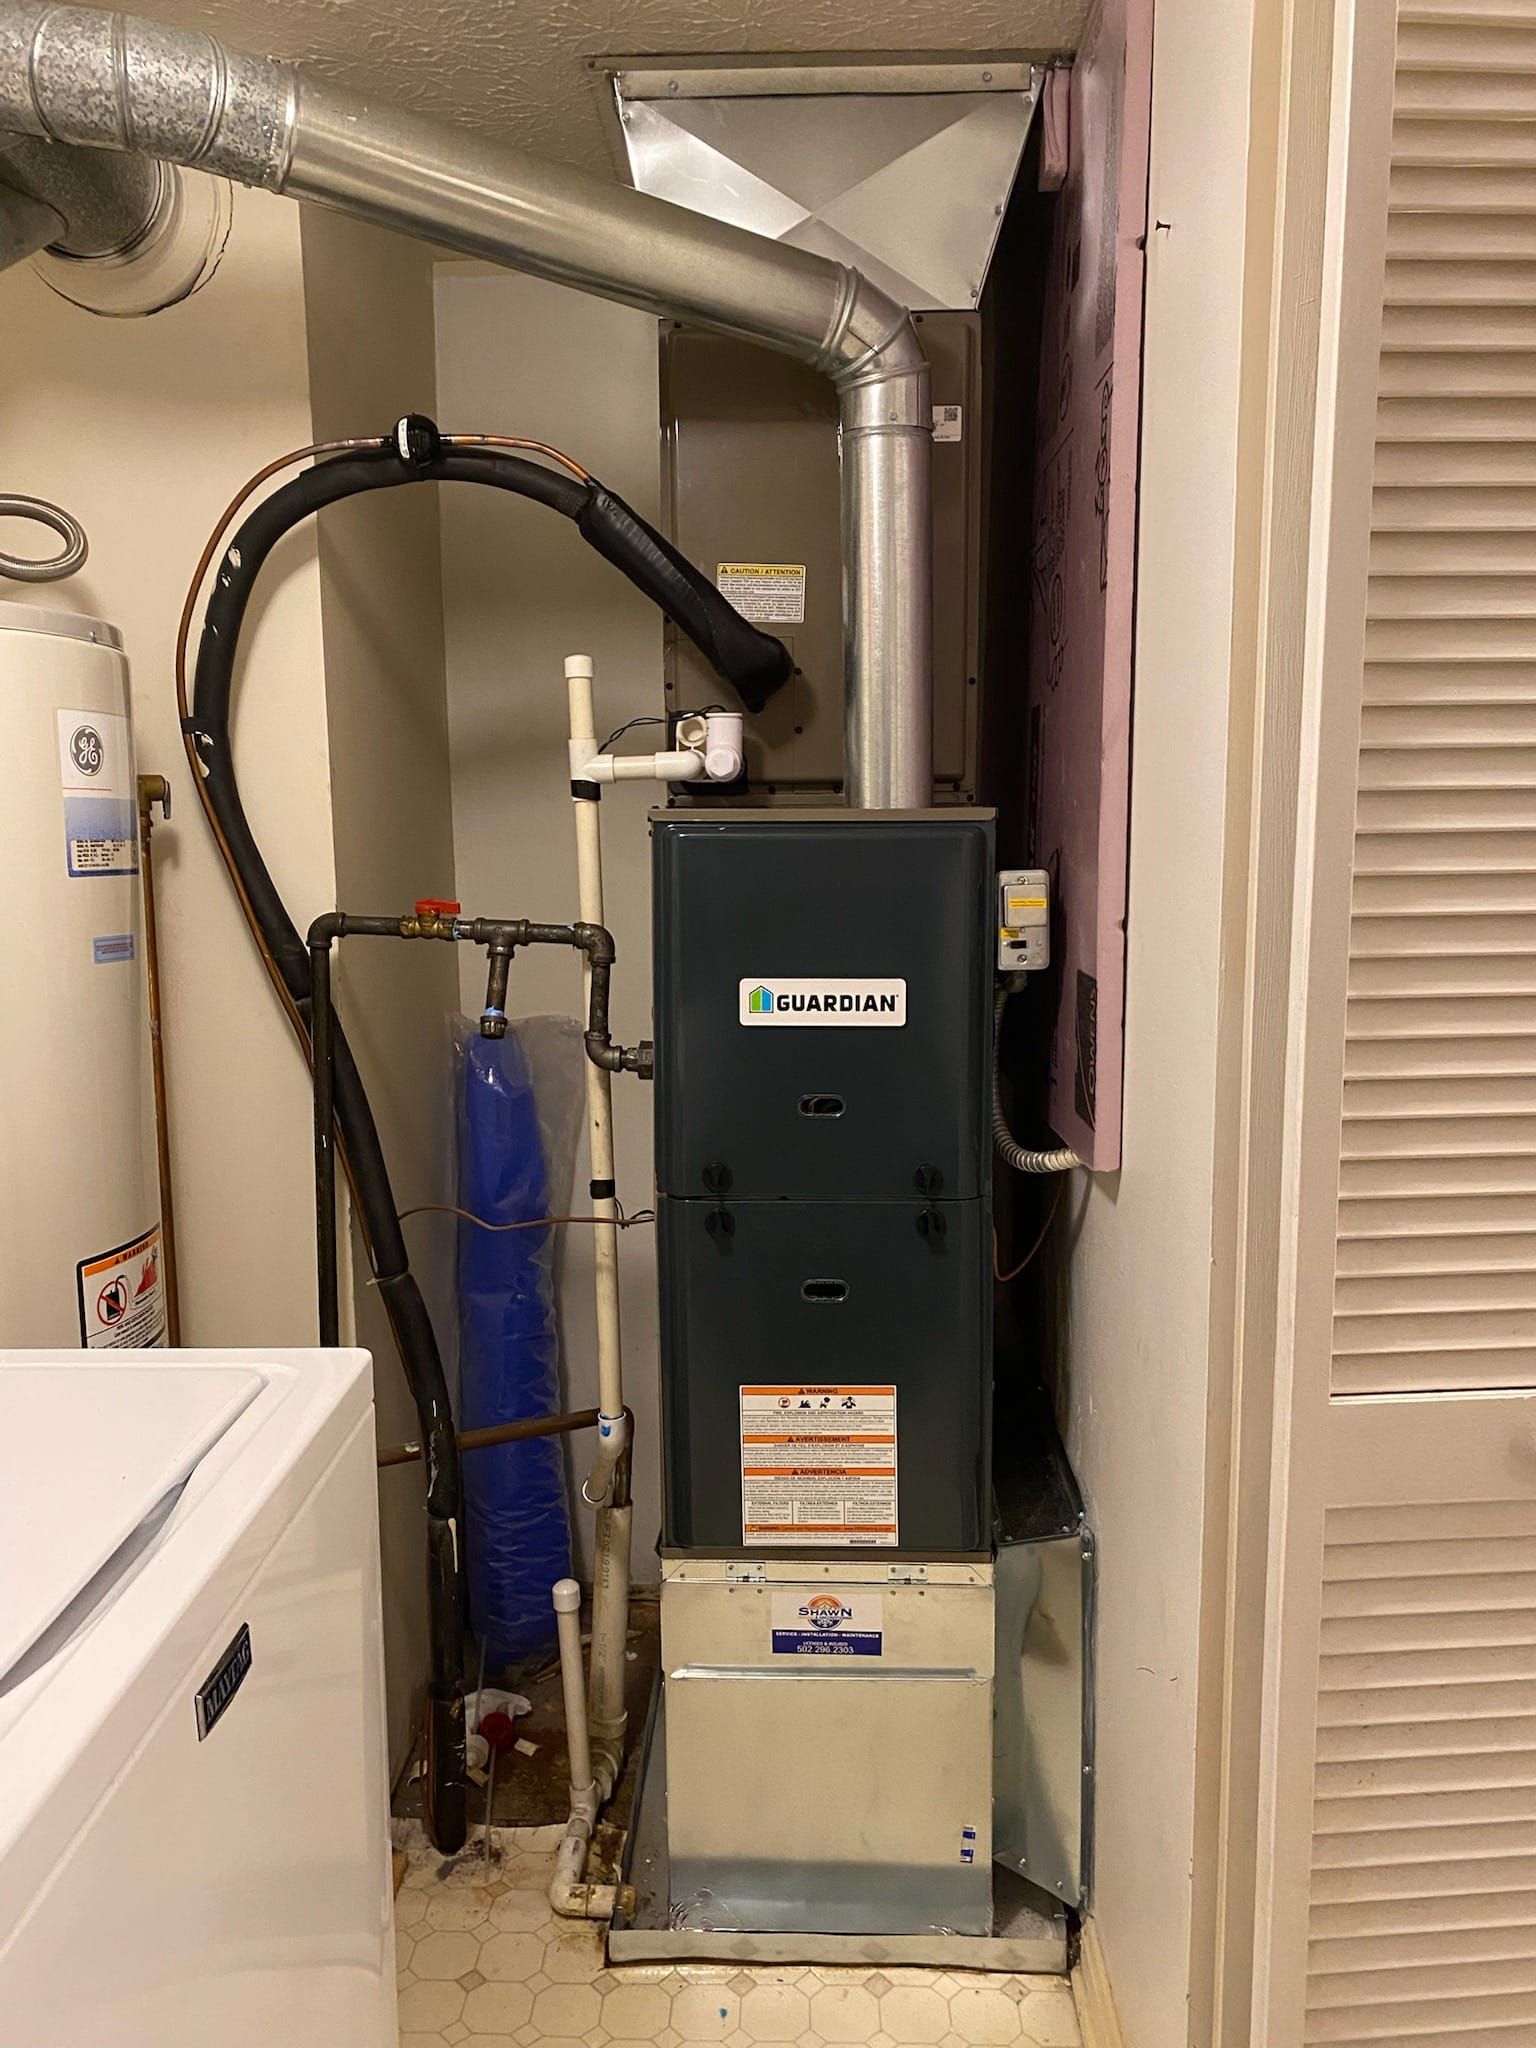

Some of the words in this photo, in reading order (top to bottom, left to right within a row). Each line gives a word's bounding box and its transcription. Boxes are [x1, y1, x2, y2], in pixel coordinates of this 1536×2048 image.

[776, 994, 896, 1012] GUARDIAN
[806, 1387, 839, 1395] WARNING
[795, 1435, 851, 1443] AVERTISSEMENT
[799, 1468, 847, 1476] ADVERTENCIA
[798, 1607, 852, 1616] SHAWN
[206, 1641, 250, 1724] MAYTAG
